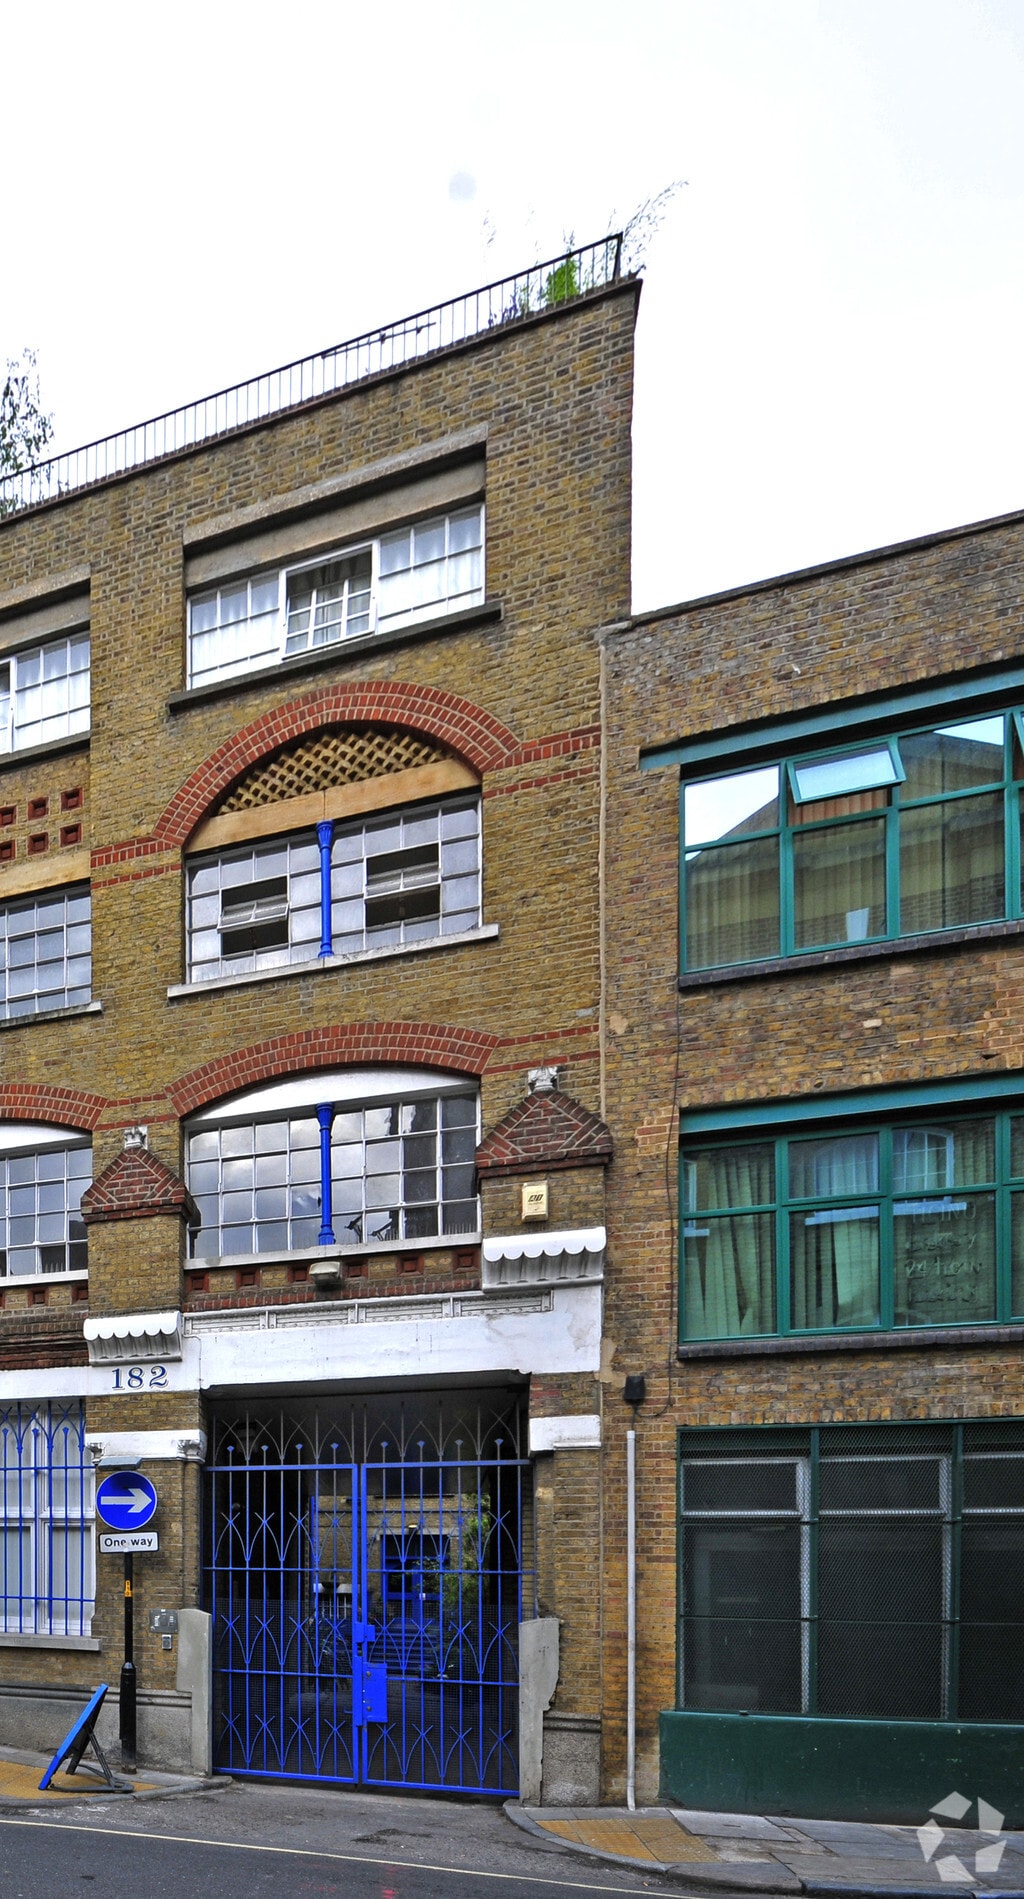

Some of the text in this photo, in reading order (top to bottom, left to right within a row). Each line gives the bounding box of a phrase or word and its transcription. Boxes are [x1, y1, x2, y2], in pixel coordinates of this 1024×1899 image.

[112, 1365, 168, 1390] 182
[104, 1538, 153, 1547] One way
